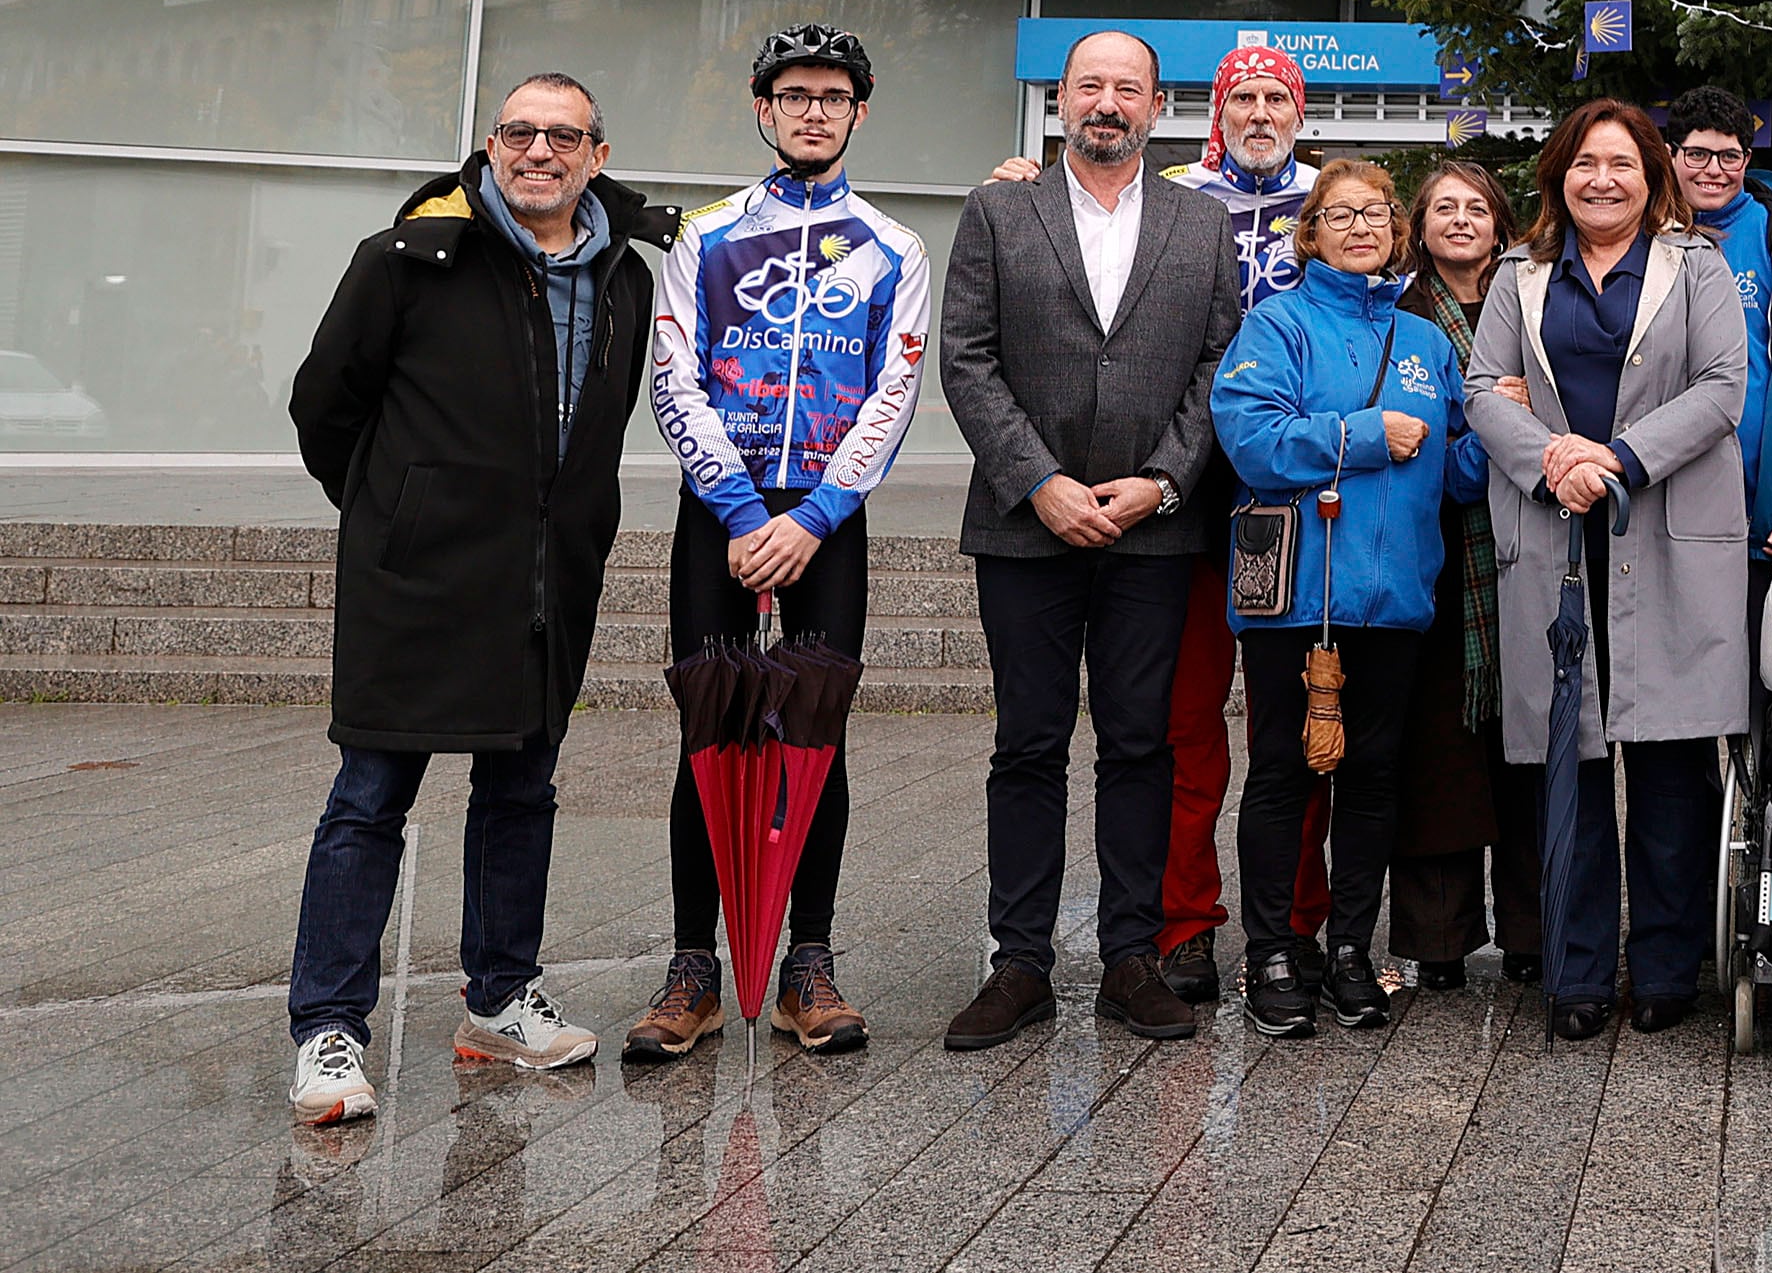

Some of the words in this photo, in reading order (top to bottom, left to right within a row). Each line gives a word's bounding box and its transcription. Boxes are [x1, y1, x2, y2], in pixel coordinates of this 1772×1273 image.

[1275, 35, 1339, 51] XUNTA
[1303, 54, 1380, 71] GALICIA
[722, 326, 864, 356] DisCamino
[727, 411, 759, 423] XUNTA
[653, 368, 725, 486] turbo10
[725, 423, 737, 433] DE
[737, 423, 783, 434] GALICIA
[836, 373, 915, 489] GRANISA
